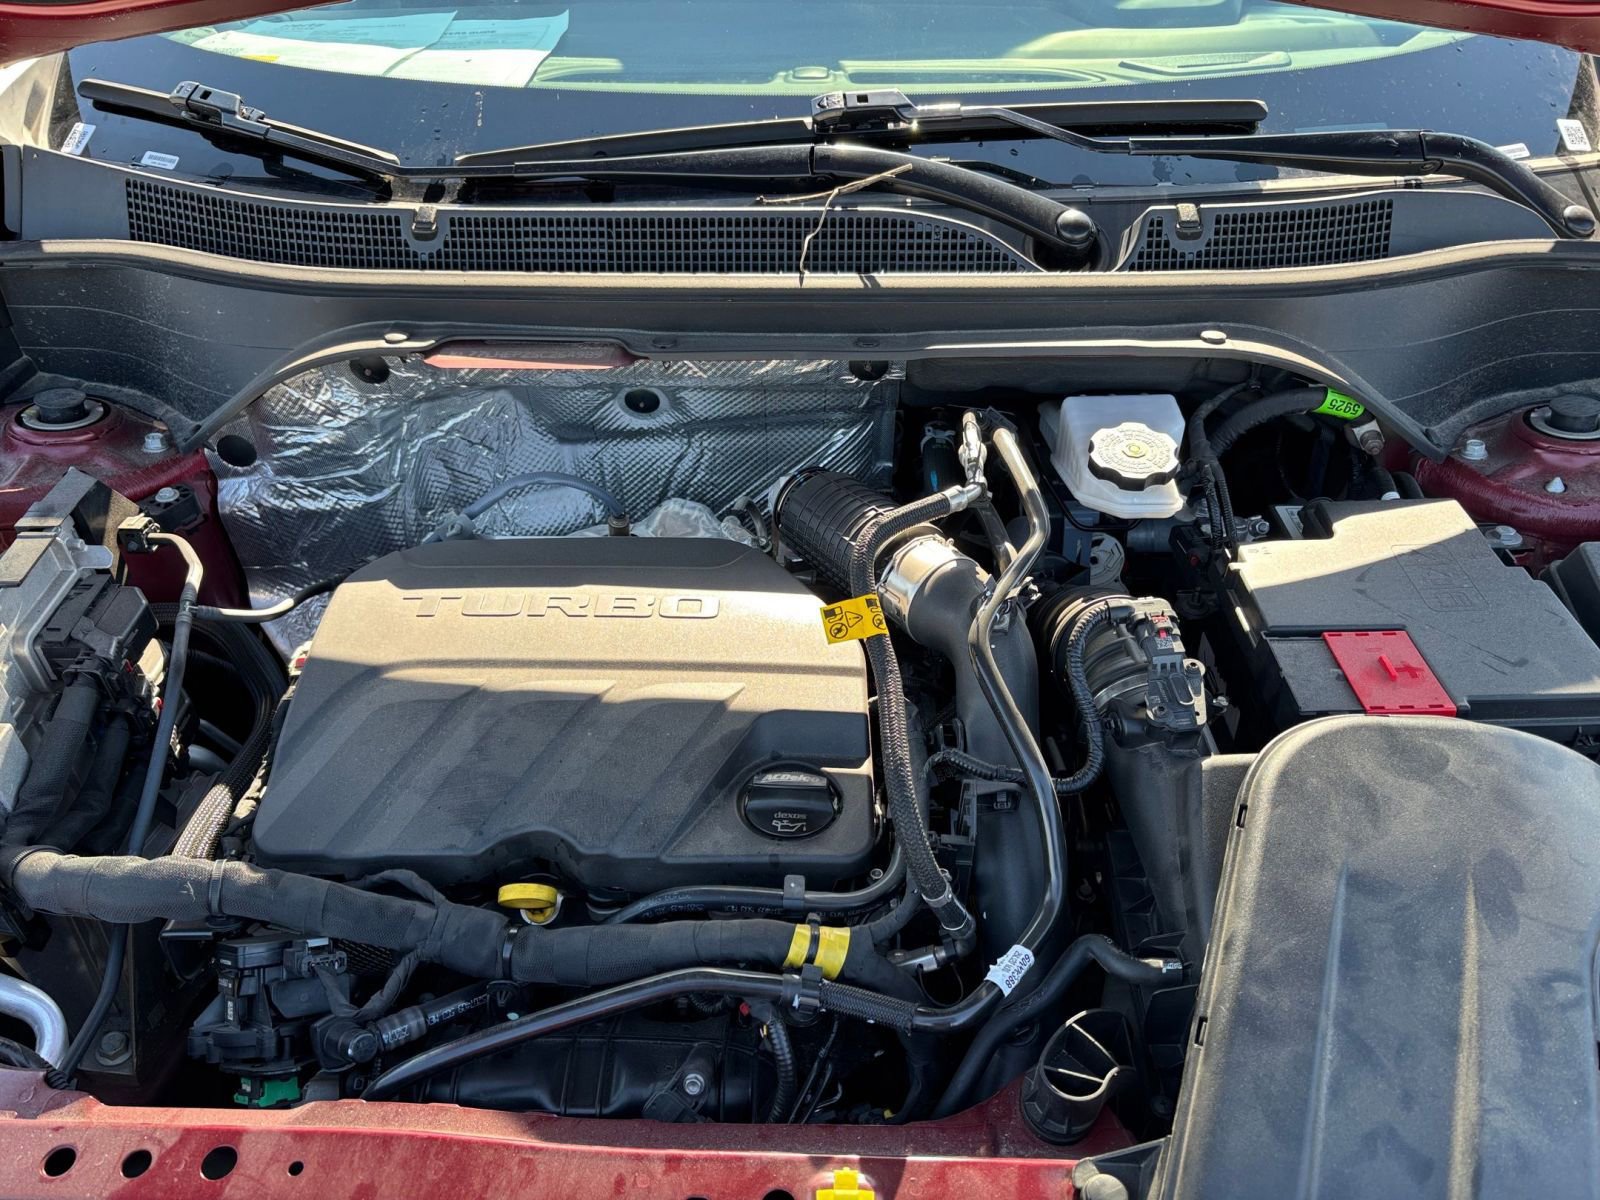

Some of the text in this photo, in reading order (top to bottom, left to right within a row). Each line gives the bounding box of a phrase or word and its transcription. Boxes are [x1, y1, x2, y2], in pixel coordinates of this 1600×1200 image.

[1327, 398, 1361, 415] 5925
[401, 593, 721, 619] TURBO
[761, 773, 821, 784] ACDelco
[774, 811, 807, 820] dexos
